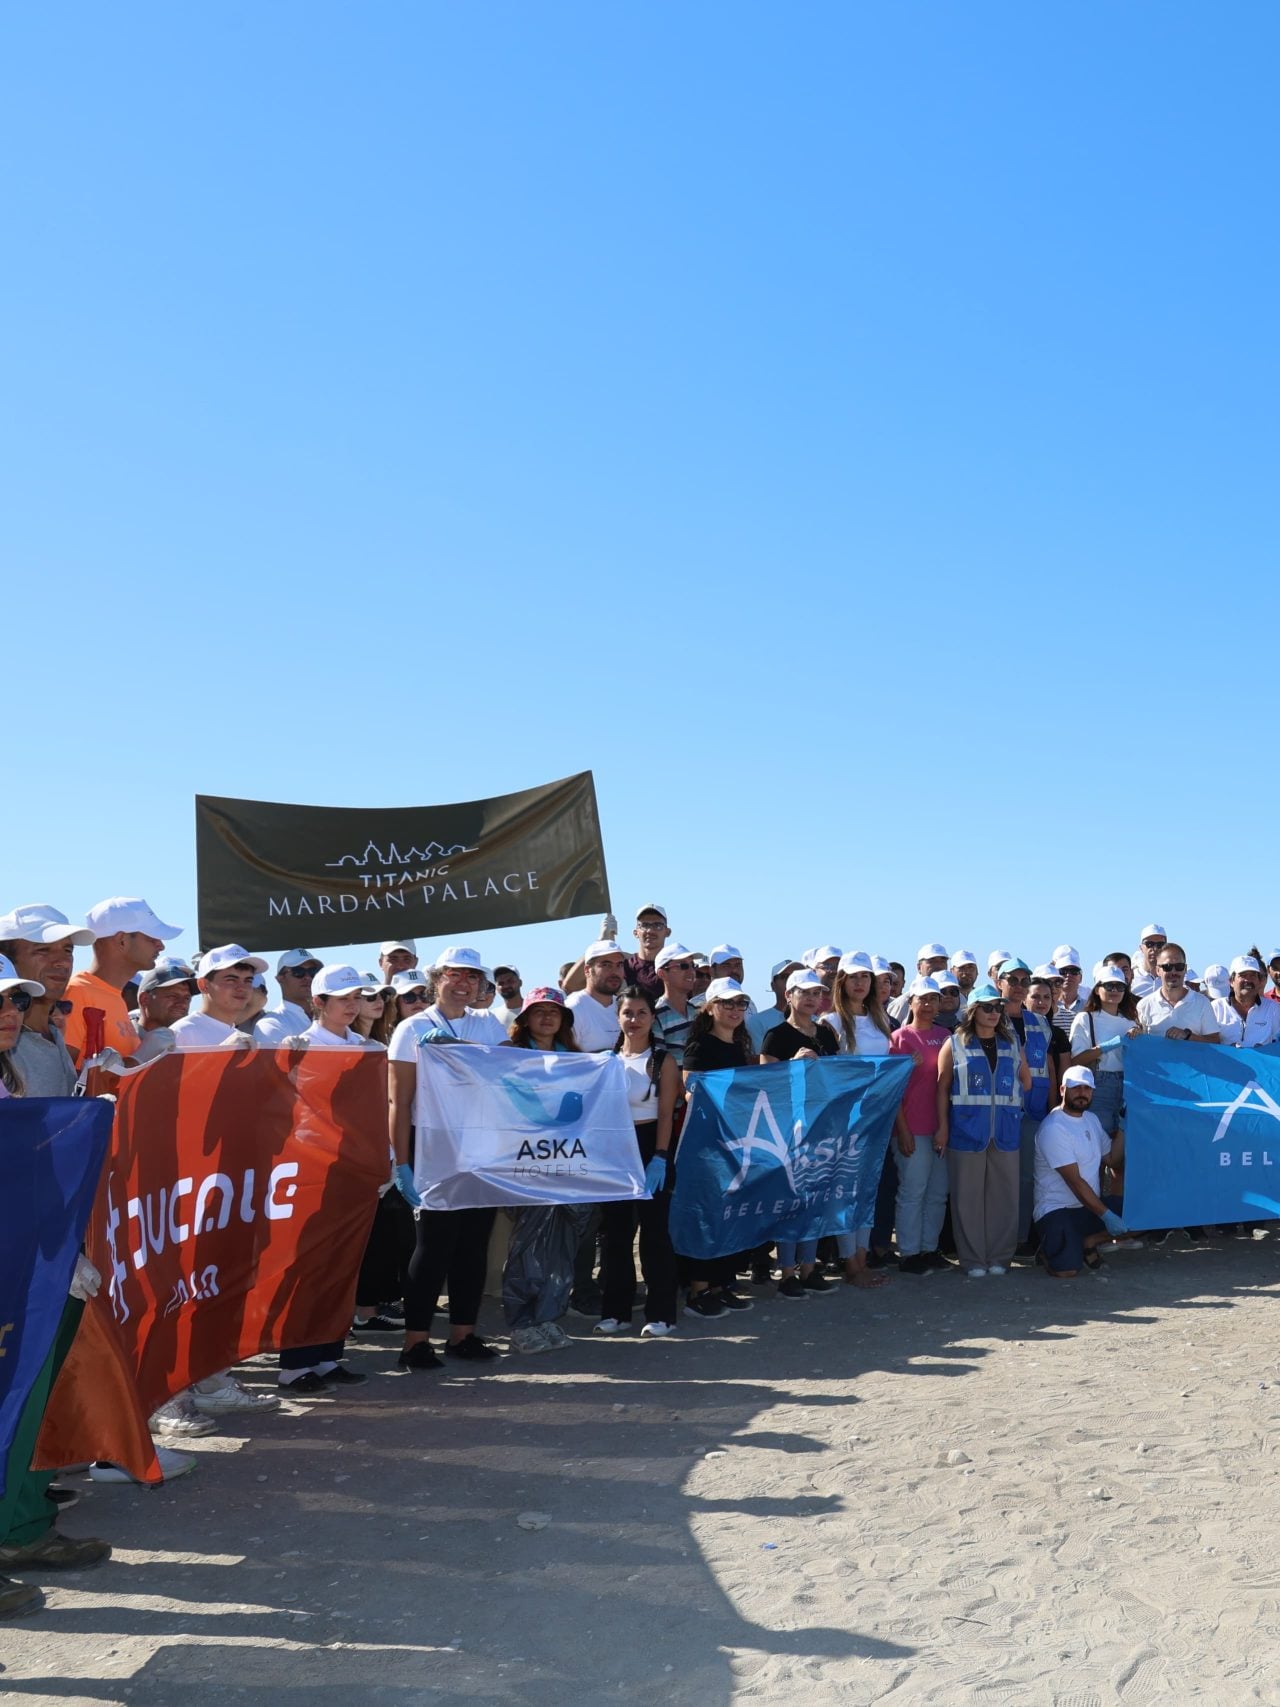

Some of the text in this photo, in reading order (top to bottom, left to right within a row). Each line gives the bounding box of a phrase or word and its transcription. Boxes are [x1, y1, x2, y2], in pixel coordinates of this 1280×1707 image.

[359, 865, 449, 888] TITANIC
[269, 871, 539, 916] MARDAN PALACE
[516, 1138, 587, 1160] ASKA
[717, 1089, 859, 1198] Aksu
[513, 1163, 588, 1178] HOTELS
